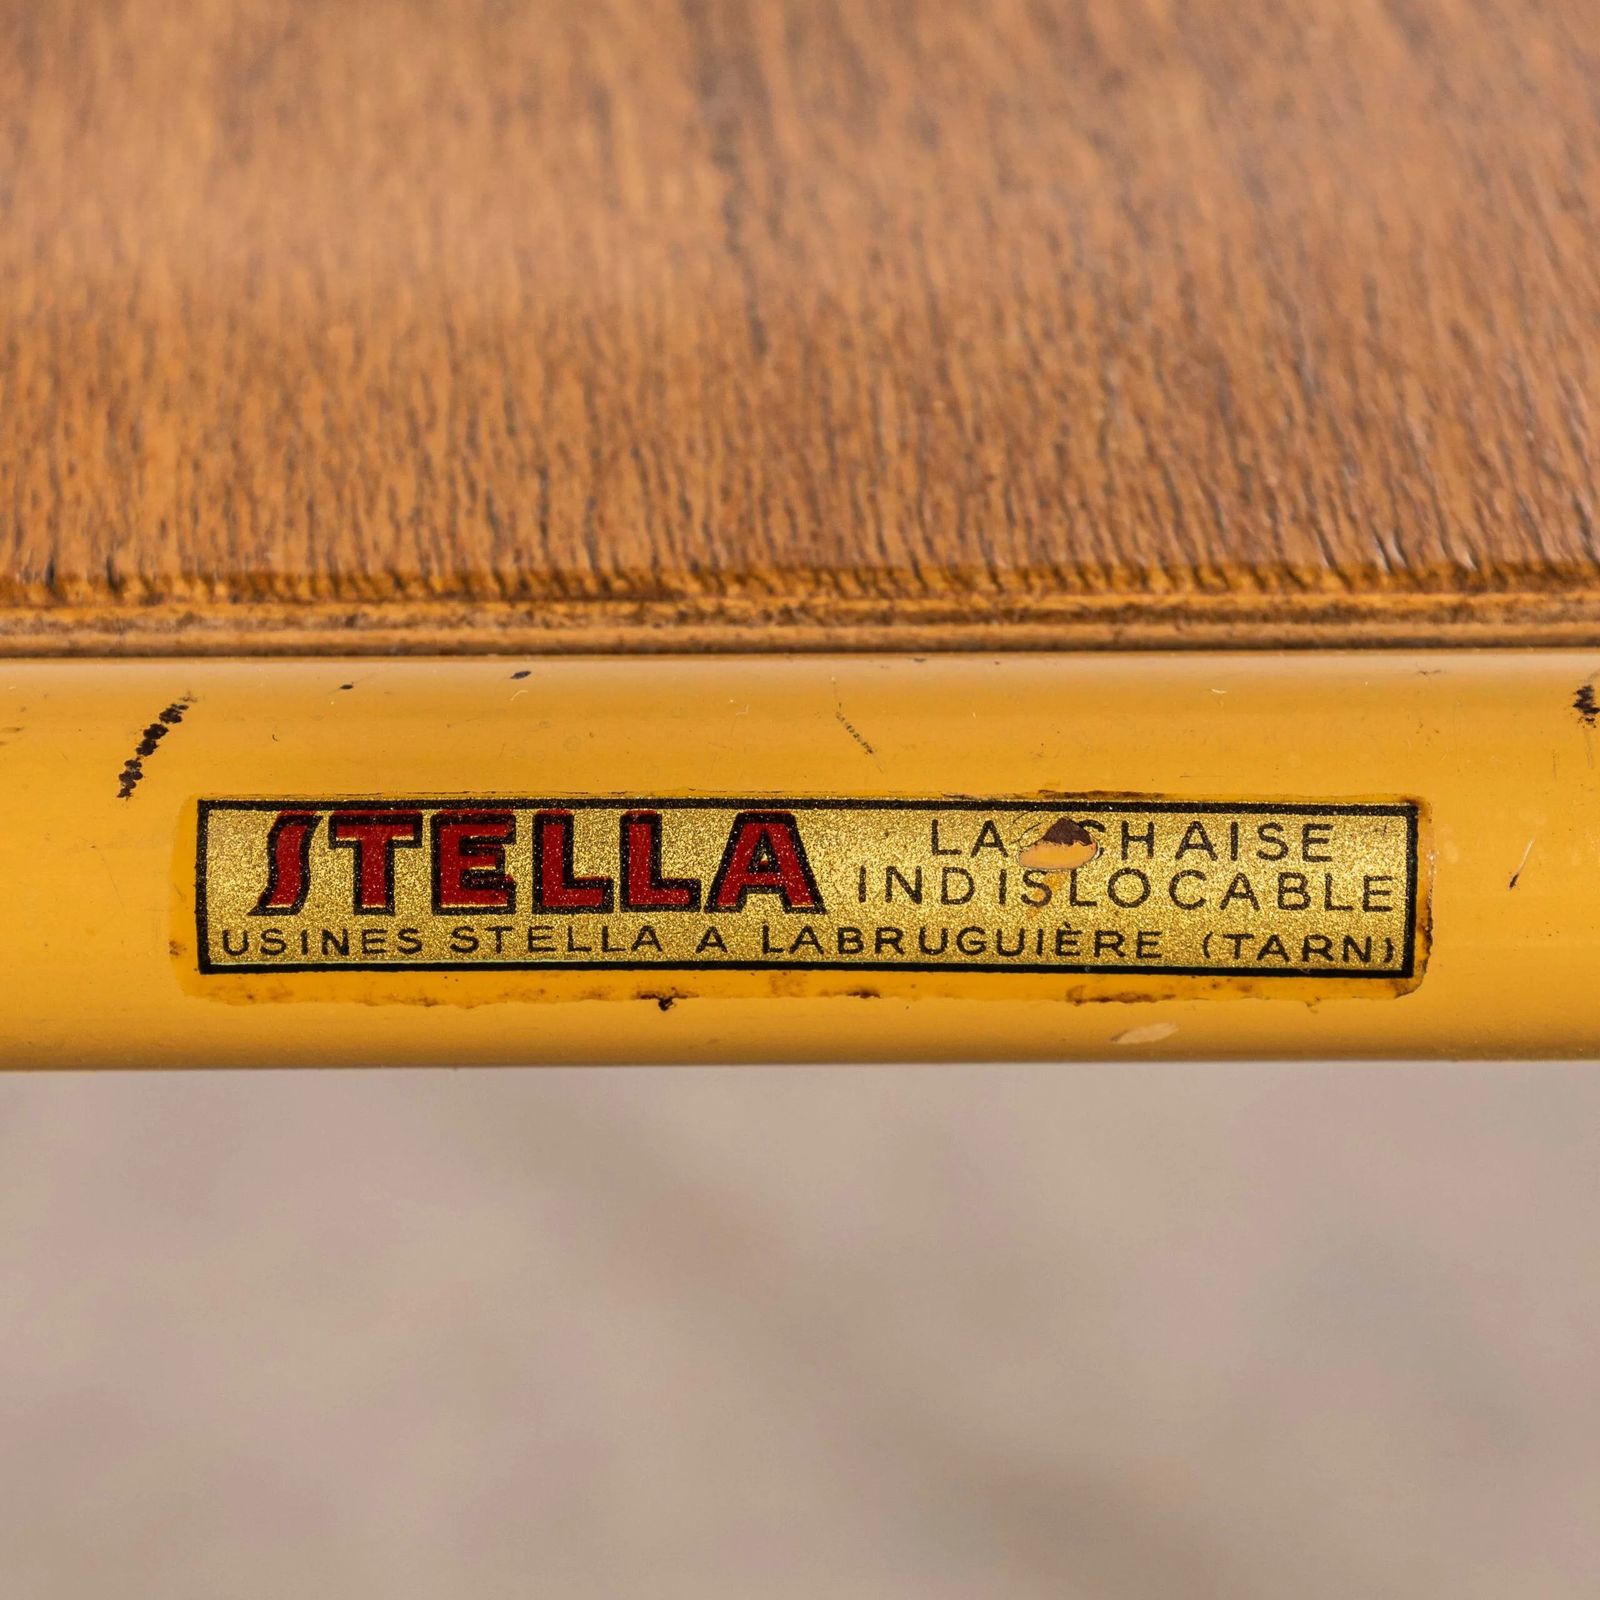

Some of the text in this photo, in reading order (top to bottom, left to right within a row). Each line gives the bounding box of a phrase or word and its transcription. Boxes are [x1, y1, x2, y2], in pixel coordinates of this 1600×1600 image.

[931, 818, 1009, 858] LA
[250, 810, 826, 915] STELLA
[858, 865, 1394, 912] INDISLOCABLE
[222, 922, 1394, 963] USINES STELLA A LABRUGUIÈRE (TARN)
